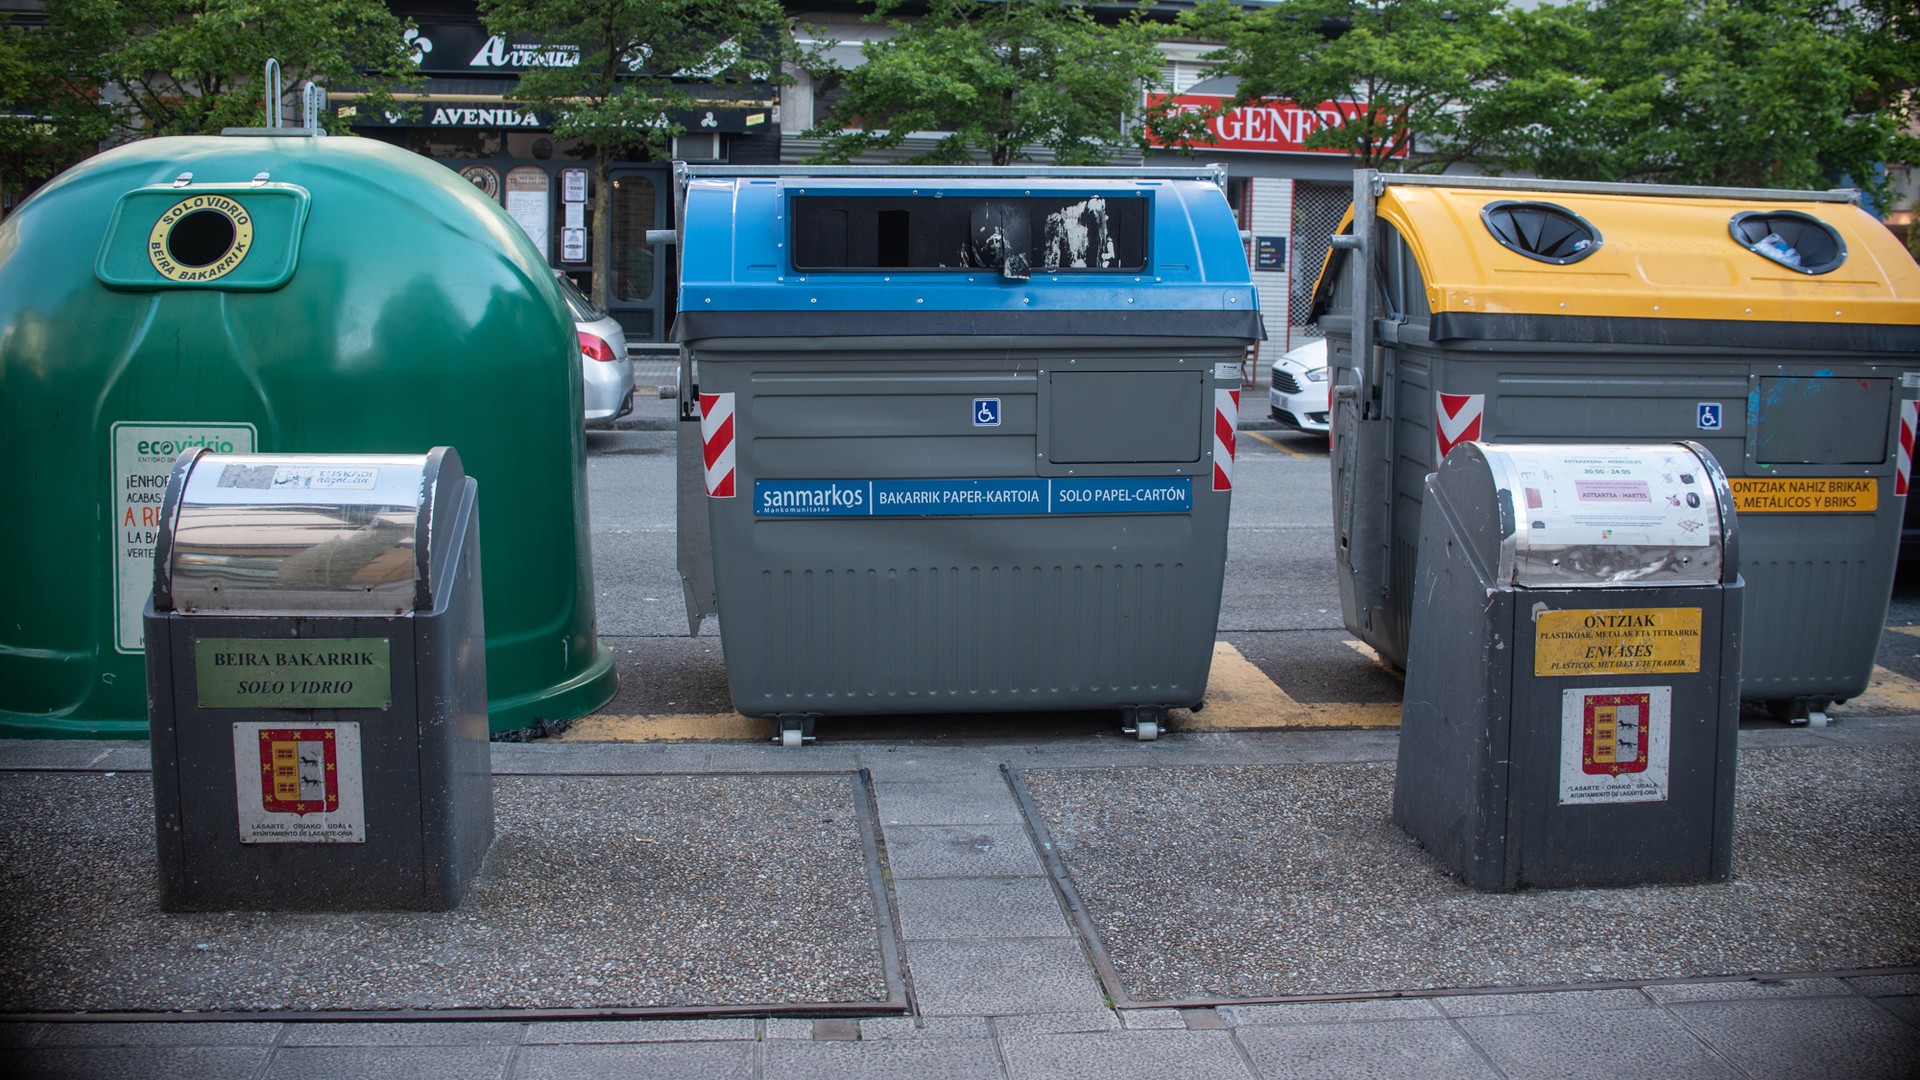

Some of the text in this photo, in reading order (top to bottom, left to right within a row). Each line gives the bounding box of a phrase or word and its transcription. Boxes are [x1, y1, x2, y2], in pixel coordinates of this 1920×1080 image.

[469, 32, 580, 67] AVENIDA
[431, 107, 540, 126] AVENIDA
[162, 196, 249, 226] SOLO VIDRIO
[151, 241, 247, 281] BEIRA BAKARRIK
[137, 435, 234, 454] ecovidrio
[1059, 486, 1185, 502] SOLO PAPEL-CARTÓN
[1733, 481, 1871, 493] ONTZIAK NAHIZ BRIKAK
[126, 493, 162, 503] ACABAS
[764, 484, 863, 509] sanmarkos
[879, 490, 1040, 505] BAKARRIK PAPER-KARTOIA
[1743, 494, 1812, 508] METÁLICOS
[1814, 497, 1821, 508] Y
[1824, 497, 1857, 508] BRIKS
[124, 506, 136, 527] A
[127, 531, 142, 544] LA
[1584, 615, 1655, 628] ONTZIAK
[1595, 630, 1633, 638] METALAK
[1635, 630, 1651, 638] ETA
[1653, 629, 1699, 637] TETRABRIK
[215, 652, 374, 666] BEIRA BAKARRIK
[1585, 644, 1653, 659] ENVASES
[1551, 661, 1596, 670] PLASTICOS,
[237, 680, 354, 695] SOLO VIDRIO
